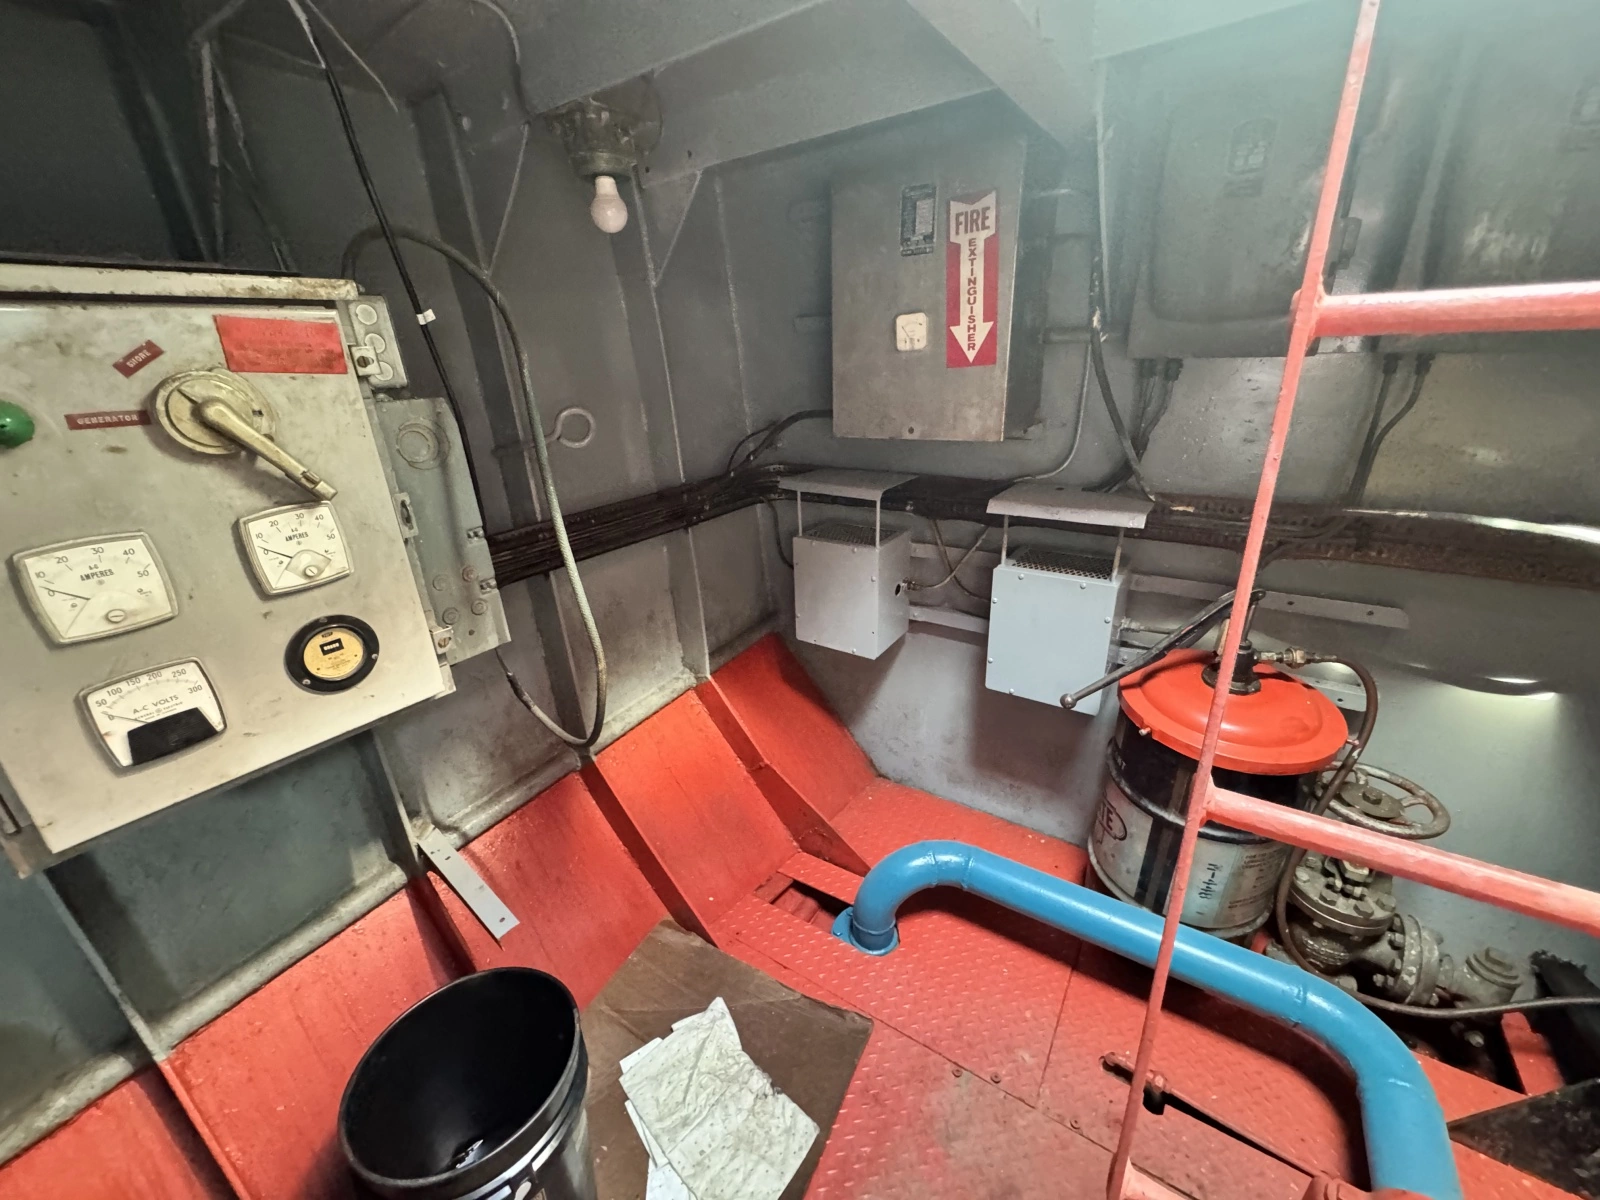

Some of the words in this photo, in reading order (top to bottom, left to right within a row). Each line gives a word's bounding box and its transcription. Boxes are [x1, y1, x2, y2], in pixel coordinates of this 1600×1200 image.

[955, 206, 991, 236] FIRE
[967, 237, 978, 351] EXTINGUISHER
[126, 349, 152, 368] SHORE
[76, 414, 139, 425] GENERATOR
[294, 512, 305, 520] 30
[269, 519, 279, 528] 20
[255, 532, 264, 540] 10
[285, 532, 309, 542] AMPERES
[92, 546, 104, 555] 30
[122, 548, 136, 556] 40
[56, 555, 69, 565] 20
[35, 571, 46, 579] 10
[80, 569, 115, 582] AMPERES
[137, 569, 150, 578] 50
[146, 670, 163, 681] 200
[172, 668, 187, 678] 250
[125, 677, 141, 687] 150
[107, 687, 123, 698] 100
[188, 684, 203, 695] 300
[95, 698, 108, 708] 50
[152, 694, 179, 707] VOLTS
